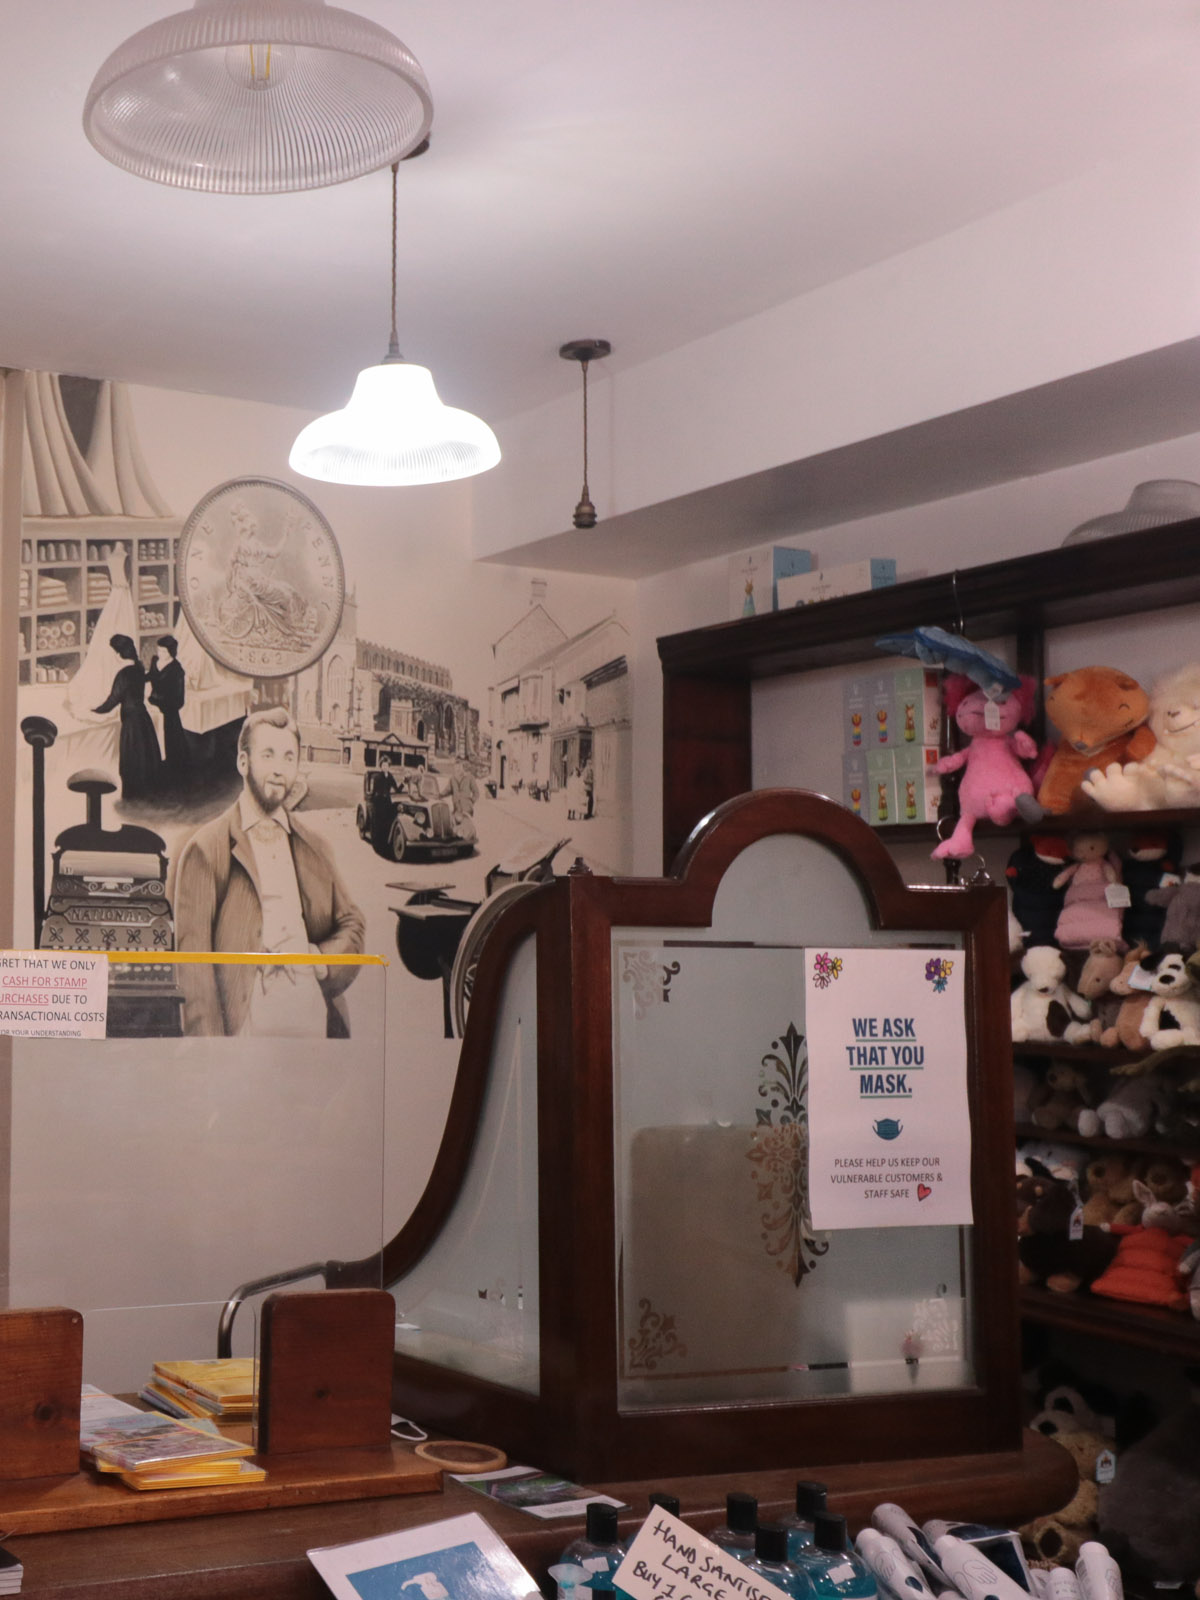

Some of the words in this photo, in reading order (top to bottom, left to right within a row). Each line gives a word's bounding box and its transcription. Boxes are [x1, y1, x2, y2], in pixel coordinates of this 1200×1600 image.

[71, 908, 146, 922] NATIONAL
[22, 959, 49, 969] THAT
[51, 960, 67, 970] WE
[70, 960, 96, 971] ONLY
[2, 975, 29, 986] CASH
[32, 976, 51, 986] FOR
[53, 977, 88, 987] STAMP
[52, 994, 71, 1005] DUE
[74, 995, 88, 1005] TO
[74, 1012, 105, 1022] COSTS
[852, 1018, 878, 1037] WE
[882, 1018, 916, 1037] ASK
[846, 1046, 887, 1066] THAT
[890, 1046, 925, 1065] YOU
[860, 1074, 913, 1094] MASK.
[834, 1158, 864, 1168] PLEASE
[866, 1158, 886, 1167] HELP
[888, 1158, 899, 1167] US
[900, 1158, 920, 1167] KEEP
[922, 1157, 940, 1167] OUR
[830, 1173, 884, 1184] VULNERABLE
[885, 1173, 935, 1183] CUSTOMERS
[936, 1173, 943, 1182] &
[864, 1189, 888, 1199] STAFF
[890, 1189, 910, 1199] SAFE
[652, 1519, 696, 1564] HAND
[632, 1560, 662, 1590] BUY
[662, 1554, 727, 1600] LARGE
